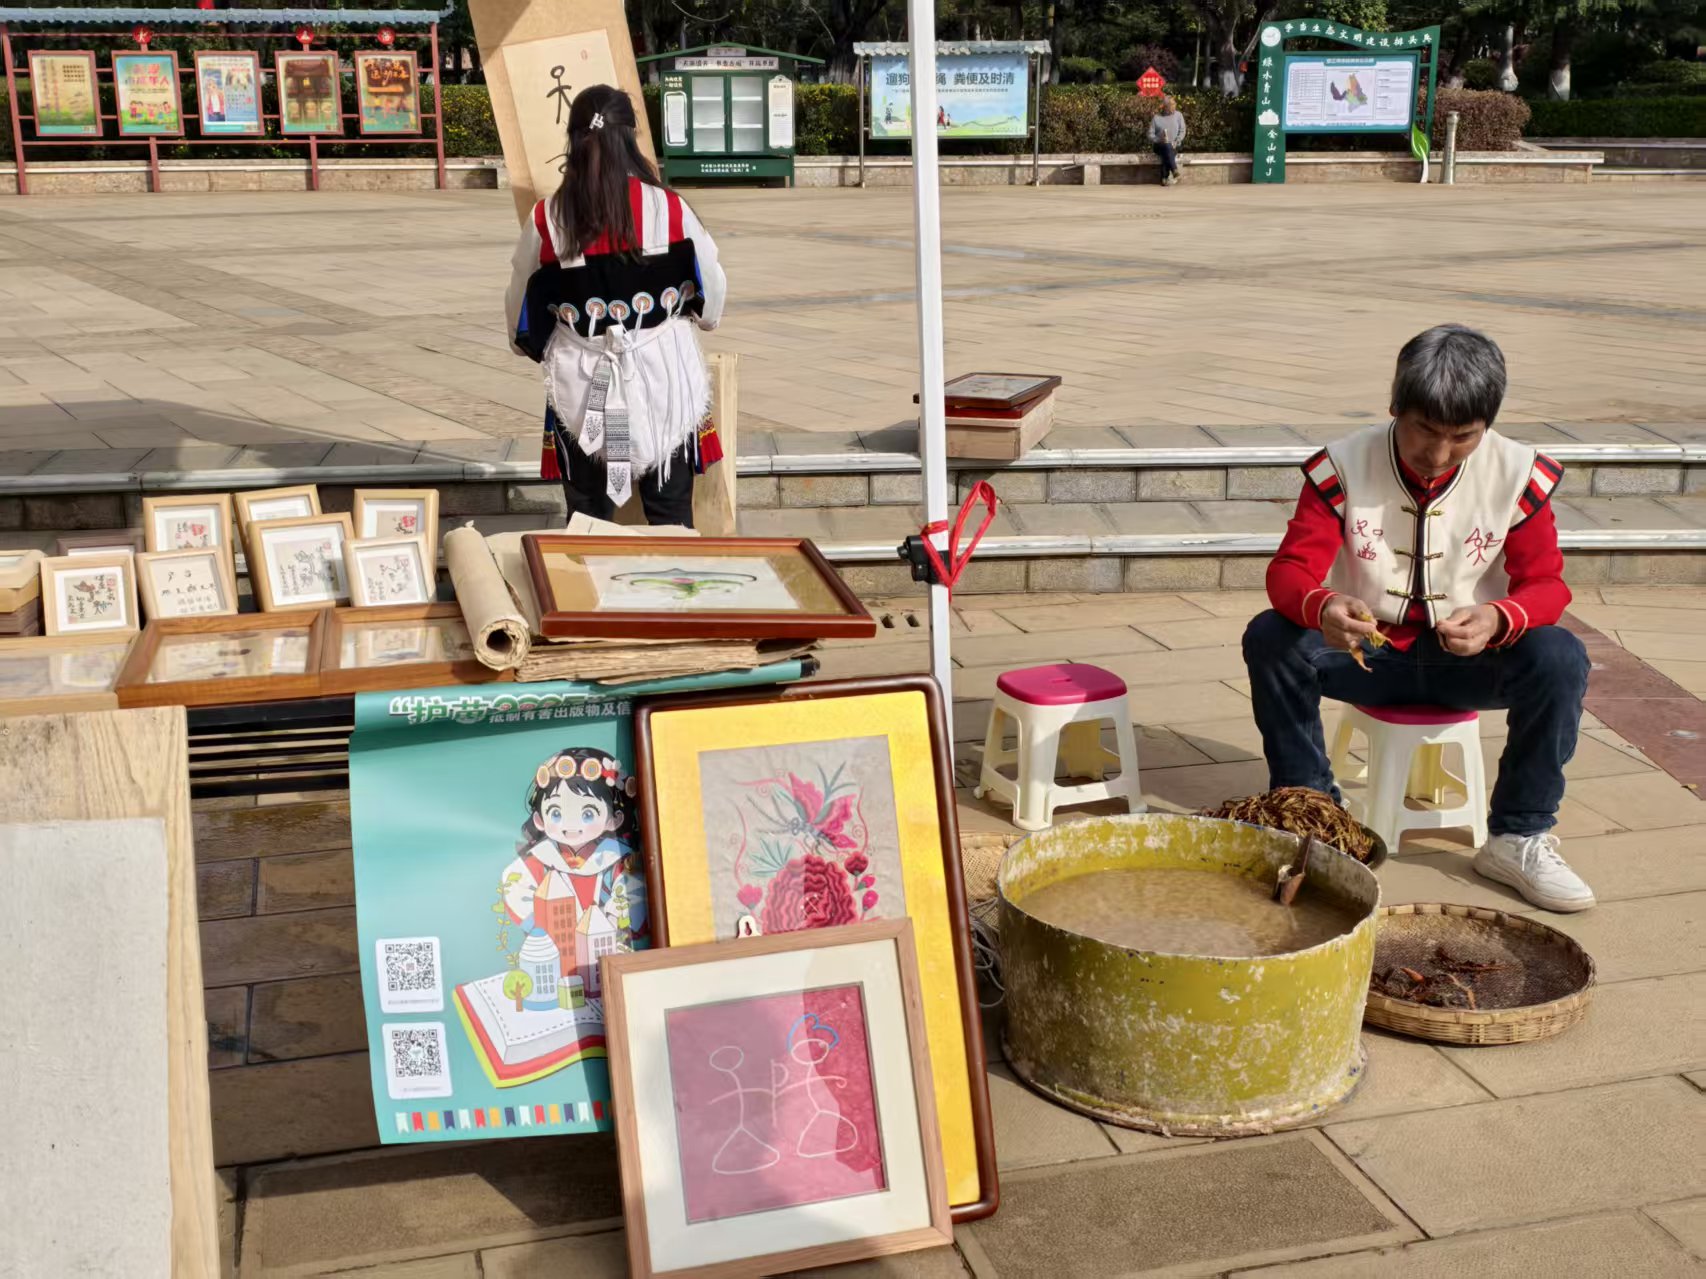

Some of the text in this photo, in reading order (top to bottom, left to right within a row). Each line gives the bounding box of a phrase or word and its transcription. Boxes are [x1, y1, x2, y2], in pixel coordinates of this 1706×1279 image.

[1284, 22, 1432, 47] 争当生态文明建设排头兵
[886, 72, 1015, 85] 遛狗绳 粪便及时清
